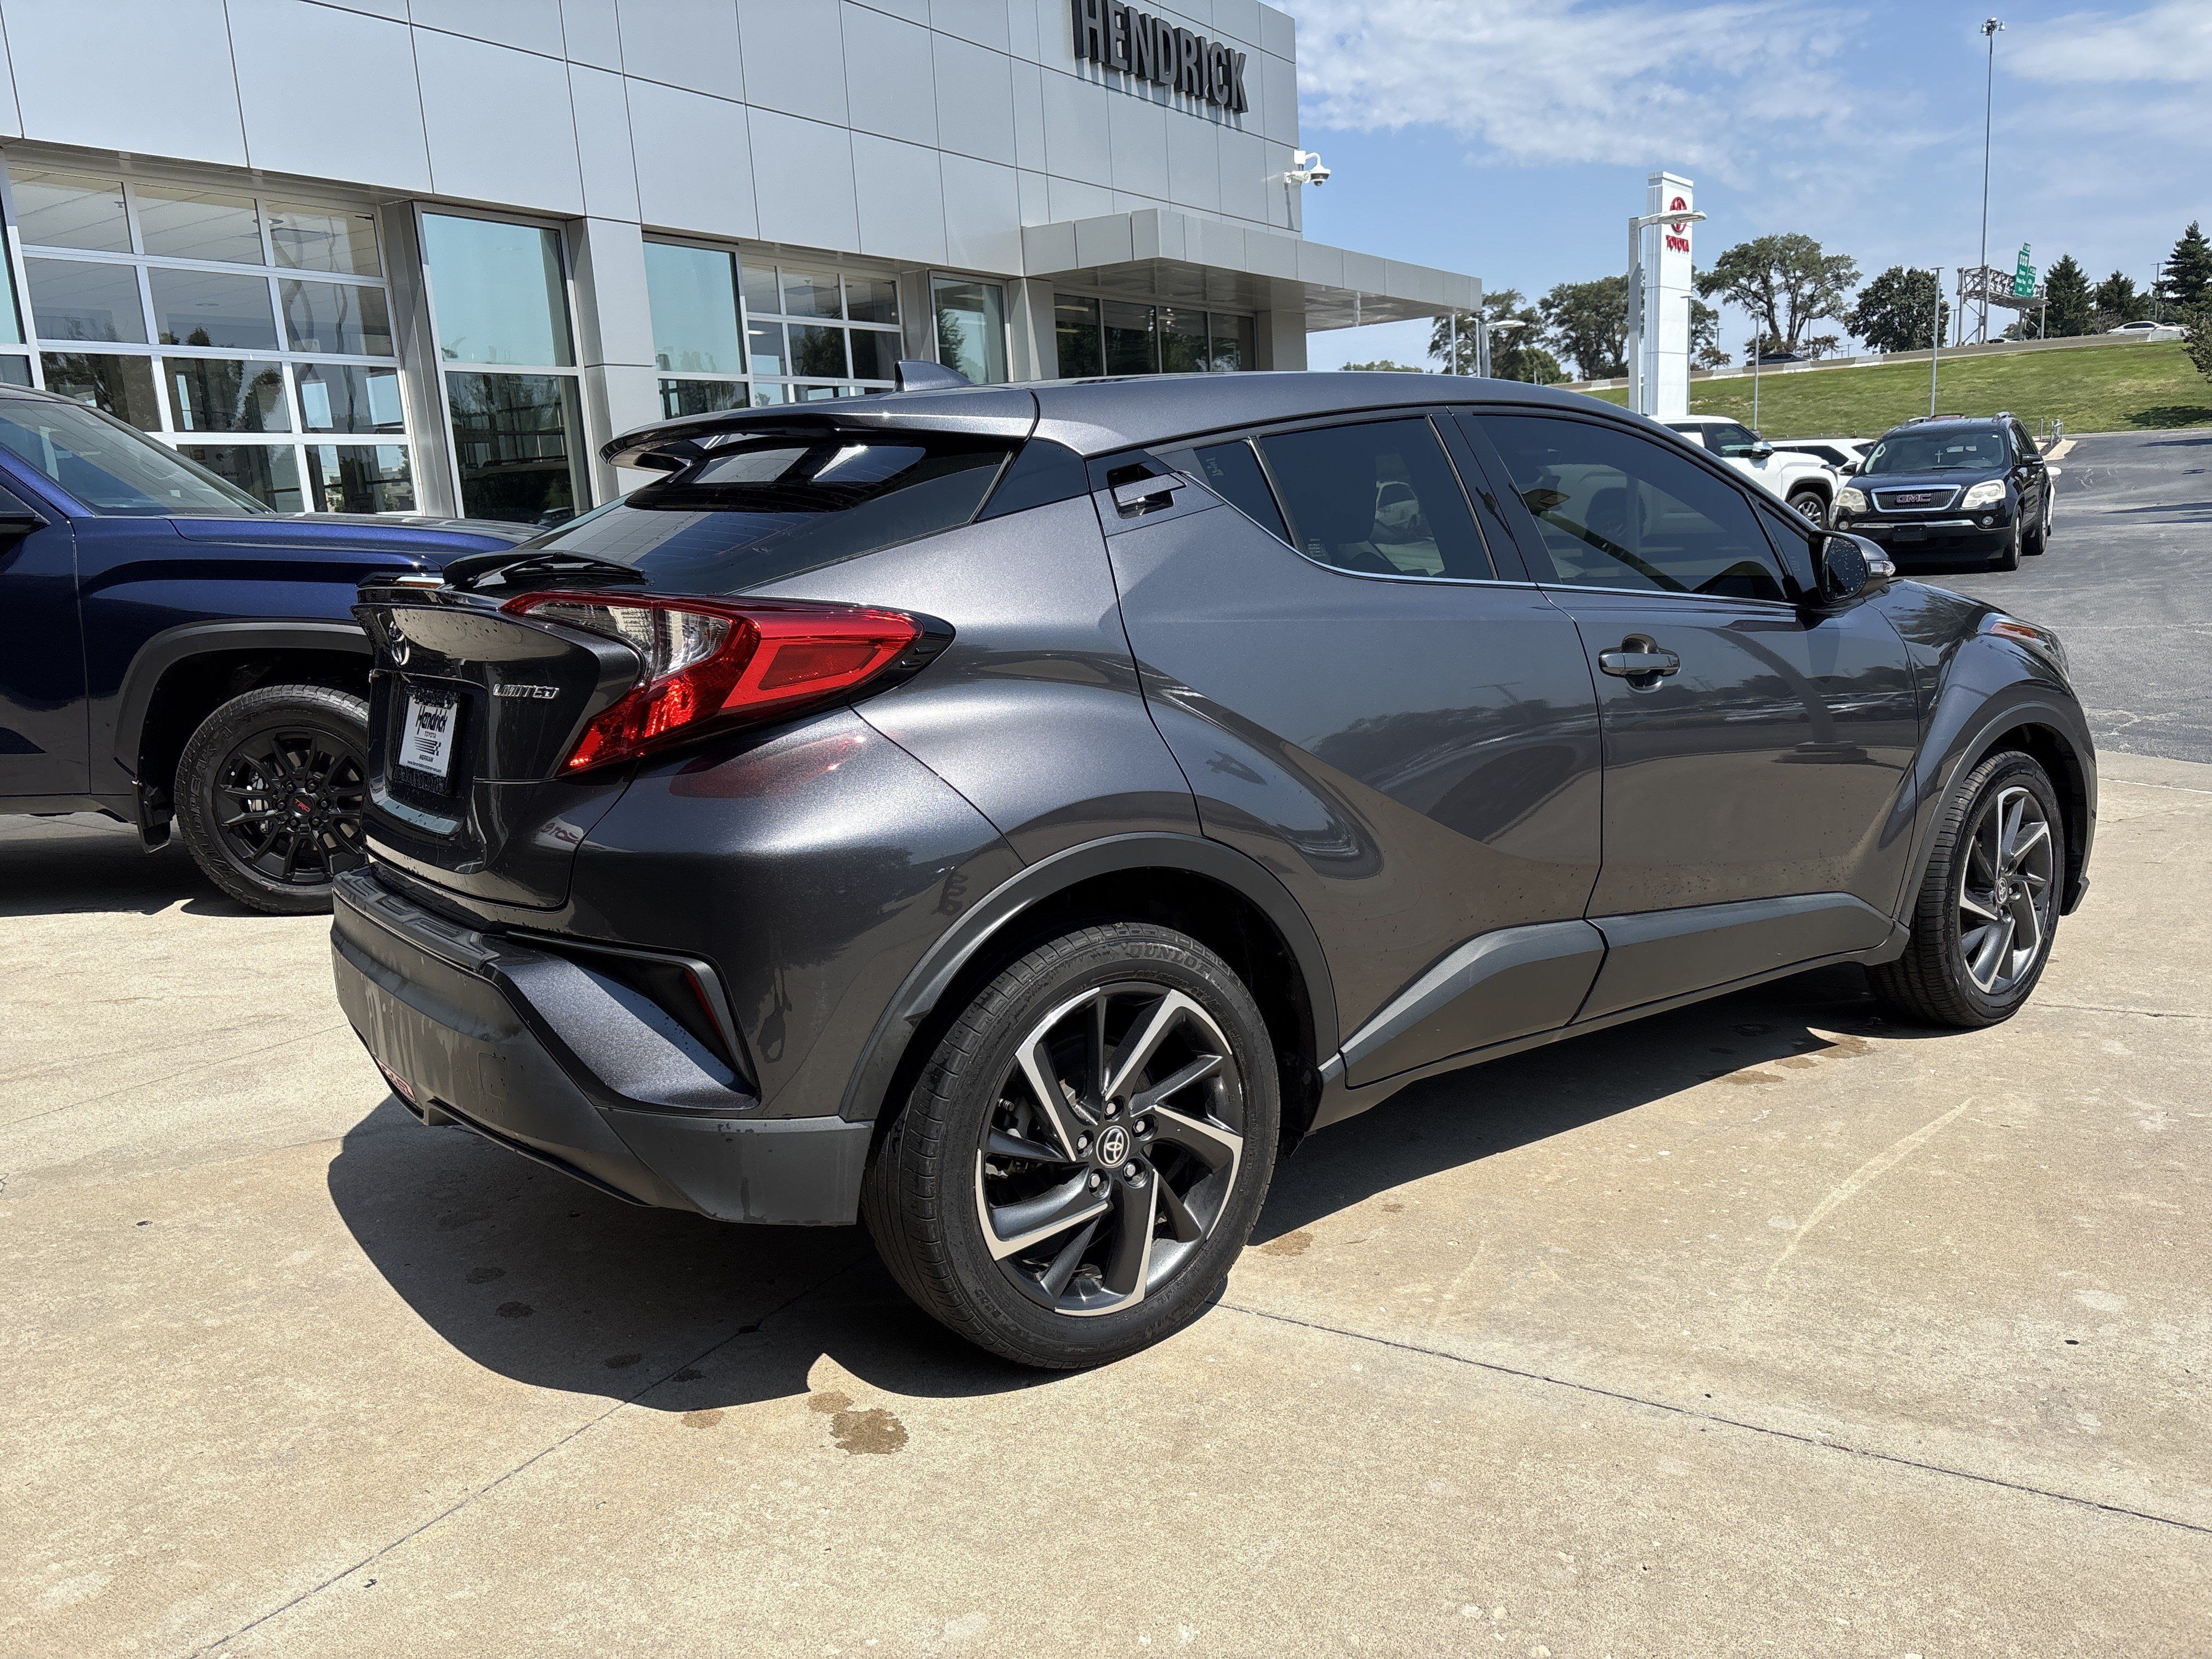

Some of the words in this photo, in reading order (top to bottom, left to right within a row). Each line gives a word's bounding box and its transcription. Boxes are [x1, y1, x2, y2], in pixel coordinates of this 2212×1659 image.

[1071, 0, 1249, 113] HENDRICK
[1666, 234, 1690, 252] TOYOTA
[1897, 493, 1932, 503] GMC
[493, 683, 560, 699] LIMITED
[415, 705, 448, 735] Hendrick
[295, 798, 311, 812] TRD
[1126, 945, 1212, 977] DUNLOP
